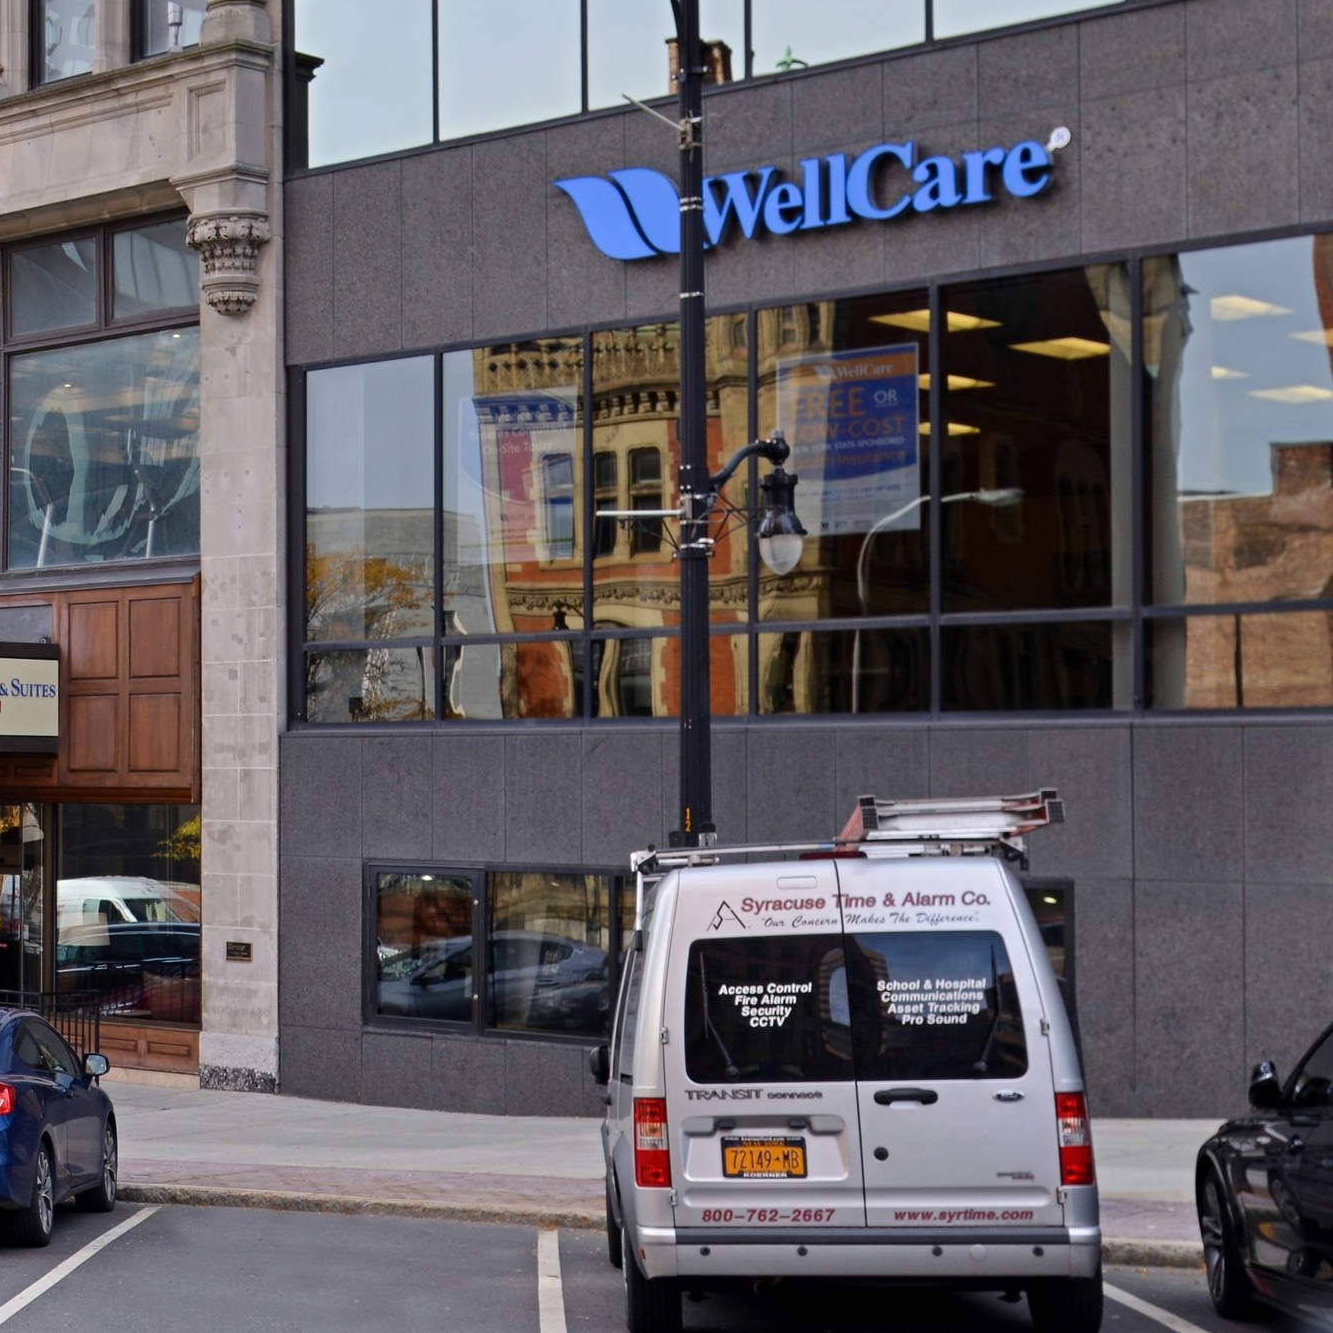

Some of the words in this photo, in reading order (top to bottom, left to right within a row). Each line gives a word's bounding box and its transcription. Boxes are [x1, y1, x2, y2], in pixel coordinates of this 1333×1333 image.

[702, 140, 1051, 249] WellCare
[835, 363, 894, 379] WellCare
[789, 385, 866, 421] FREE
[873, 388, 898, 405] OR
[11, 678, 56, 698] SUITES
[741, 896, 826, 915] Syracuse
[832, 893, 876, 908] Time
[883, 894, 896, 907] &
[901, 891, 955, 907] Alarm
[961, 890, 991, 906] Co.
[791, 916, 838, 928] Concern
[844, 914, 886, 925] Makes
[889, 913, 911, 924] The
[718, 984, 764, 996] Access
[767, 981, 813, 994] Control
[876, 979, 921, 992] School
[923, 978, 933, 990] &
[935, 977, 987, 992] Hospital
[734, 995, 758, 1006] Fire
[760, 994, 797, 1005] Alarm
[881, 989, 984, 1003] Communications
[741, 1004, 792, 1018] Security
[887, 1002, 924, 1014] Asset
[927, 1001, 981, 1015] Tracking
[749, 1016, 786, 1028] CCTV
[901, 1014, 924, 1026] Pro
[926, 1013, 968, 1025] Sound
[685, 1089, 763, 1101] TRANSIT
[702, 1209, 836, 1223] 800-762-2667
[894, 1209, 1034, 1223] www.syrtime.com
